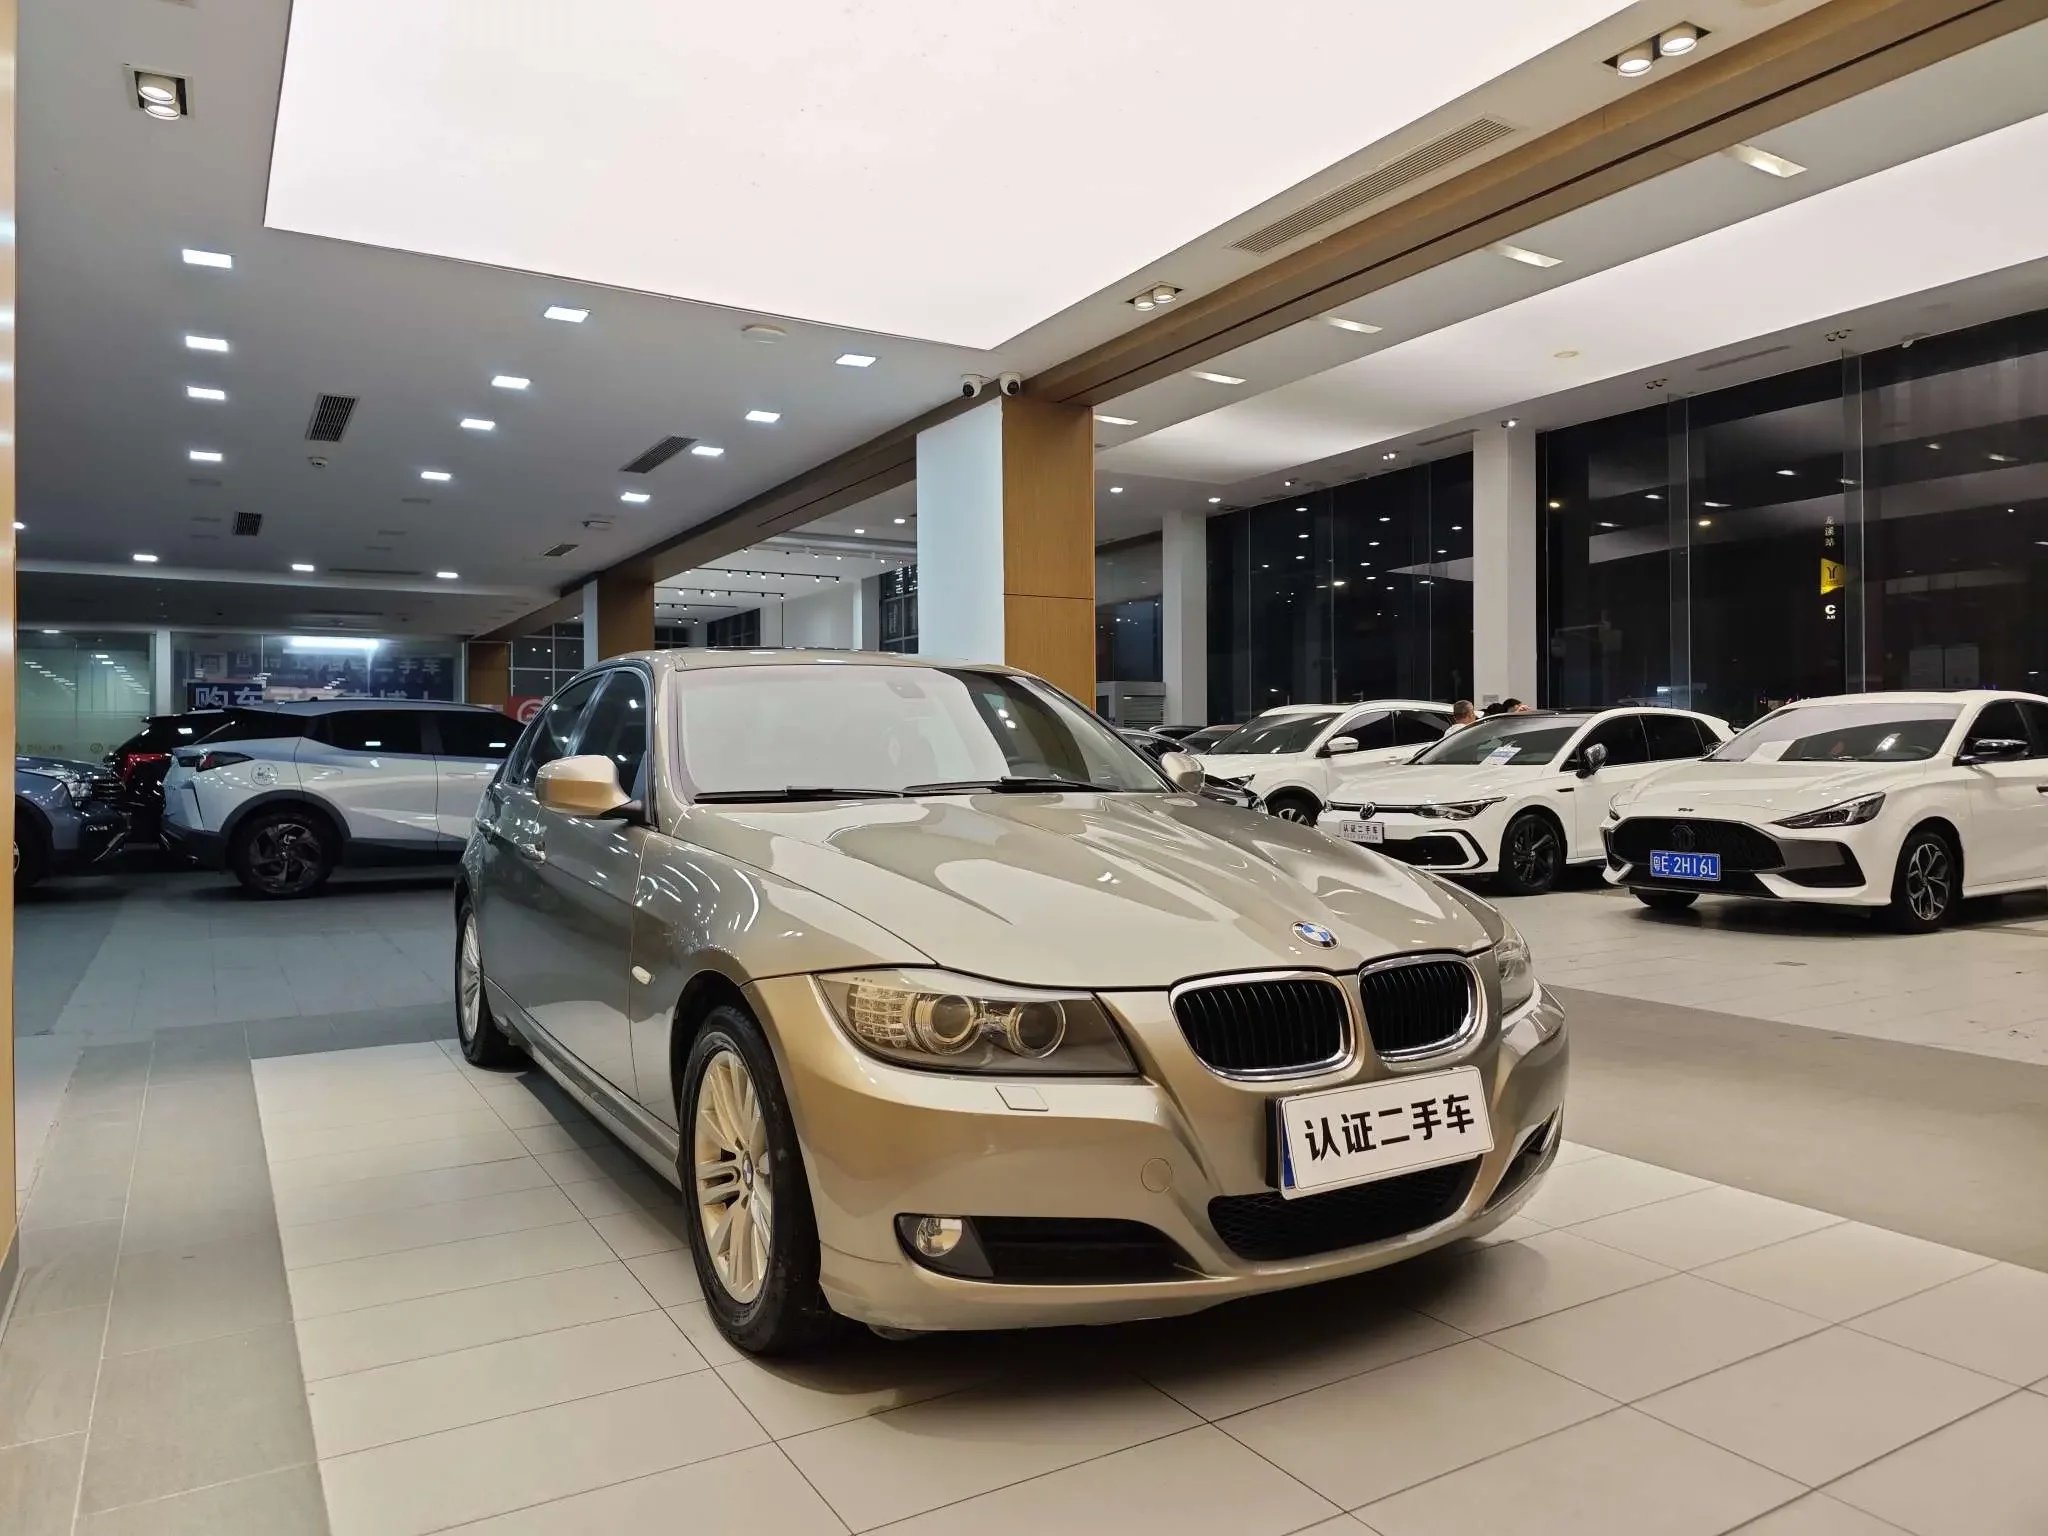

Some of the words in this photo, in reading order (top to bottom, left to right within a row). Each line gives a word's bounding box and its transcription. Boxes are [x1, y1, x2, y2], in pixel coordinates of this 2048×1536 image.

[1824, 604, 1836, 615] C
[1304, 1094, 1475, 1161] 认证二手车
